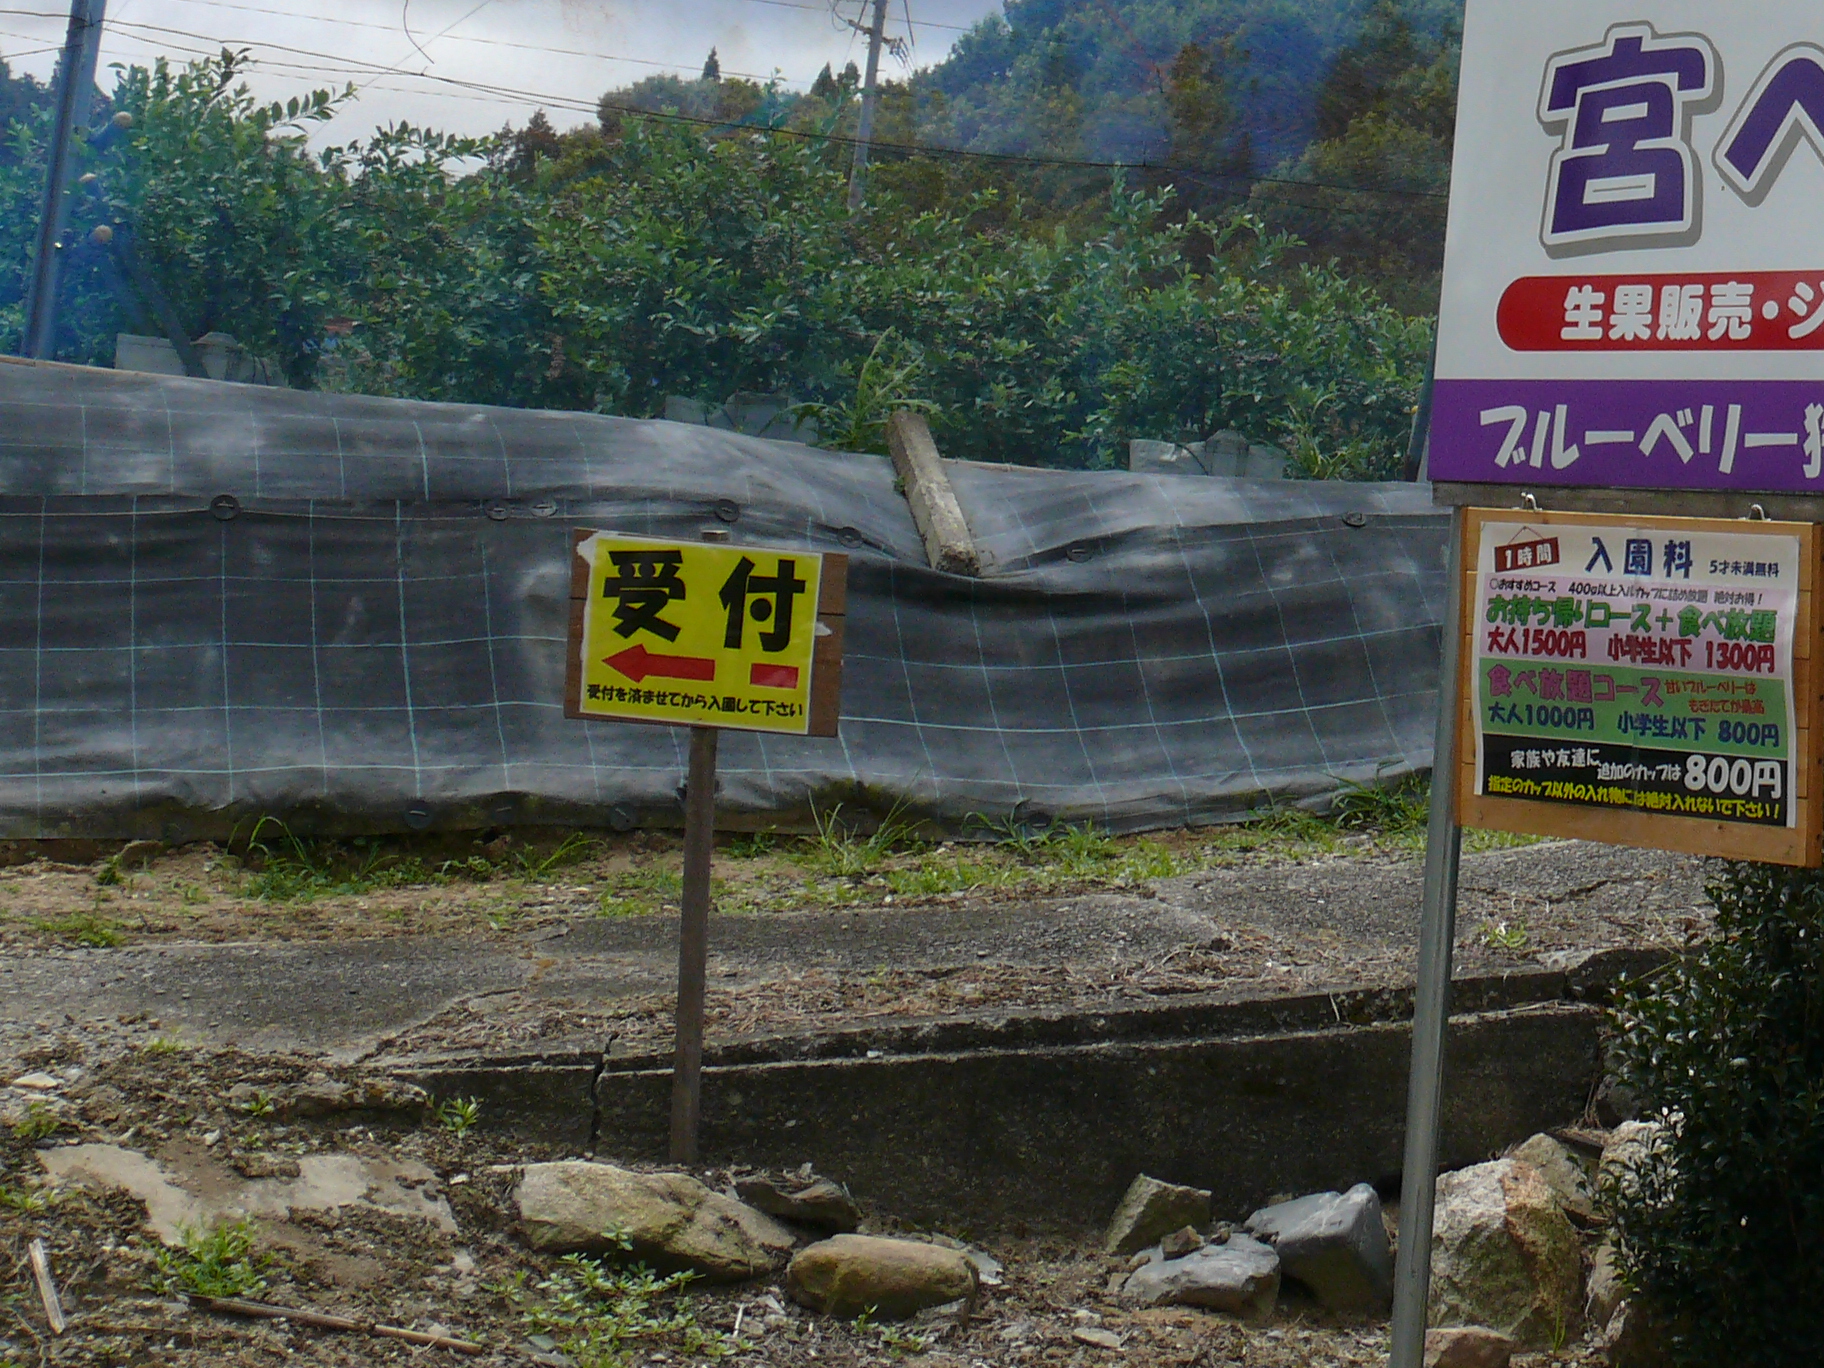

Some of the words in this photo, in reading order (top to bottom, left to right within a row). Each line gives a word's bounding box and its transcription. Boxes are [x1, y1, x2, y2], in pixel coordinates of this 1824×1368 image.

[1505, 542, 1553, 570] 1時間
[1585, 537, 1693, 578] 入園料
[1708, 559, 1780, 578] 5才未満無料
[602, 549, 807, 653] 受付
[1487, 626, 1588, 659] 大人1500円
[1607, 634, 1694, 668] 小学生以下
[1705, 640, 1776, 674] 1300円
[1486, 663, 1665, 709] 食べ放題コース
[1487, 701, 1597, 731] 大人1000円
[1616, 711, 1707, 741] 小学生以下
[1717, 720, 1781, 748] 800円
[1684, 754, 1783, 800] 800円
